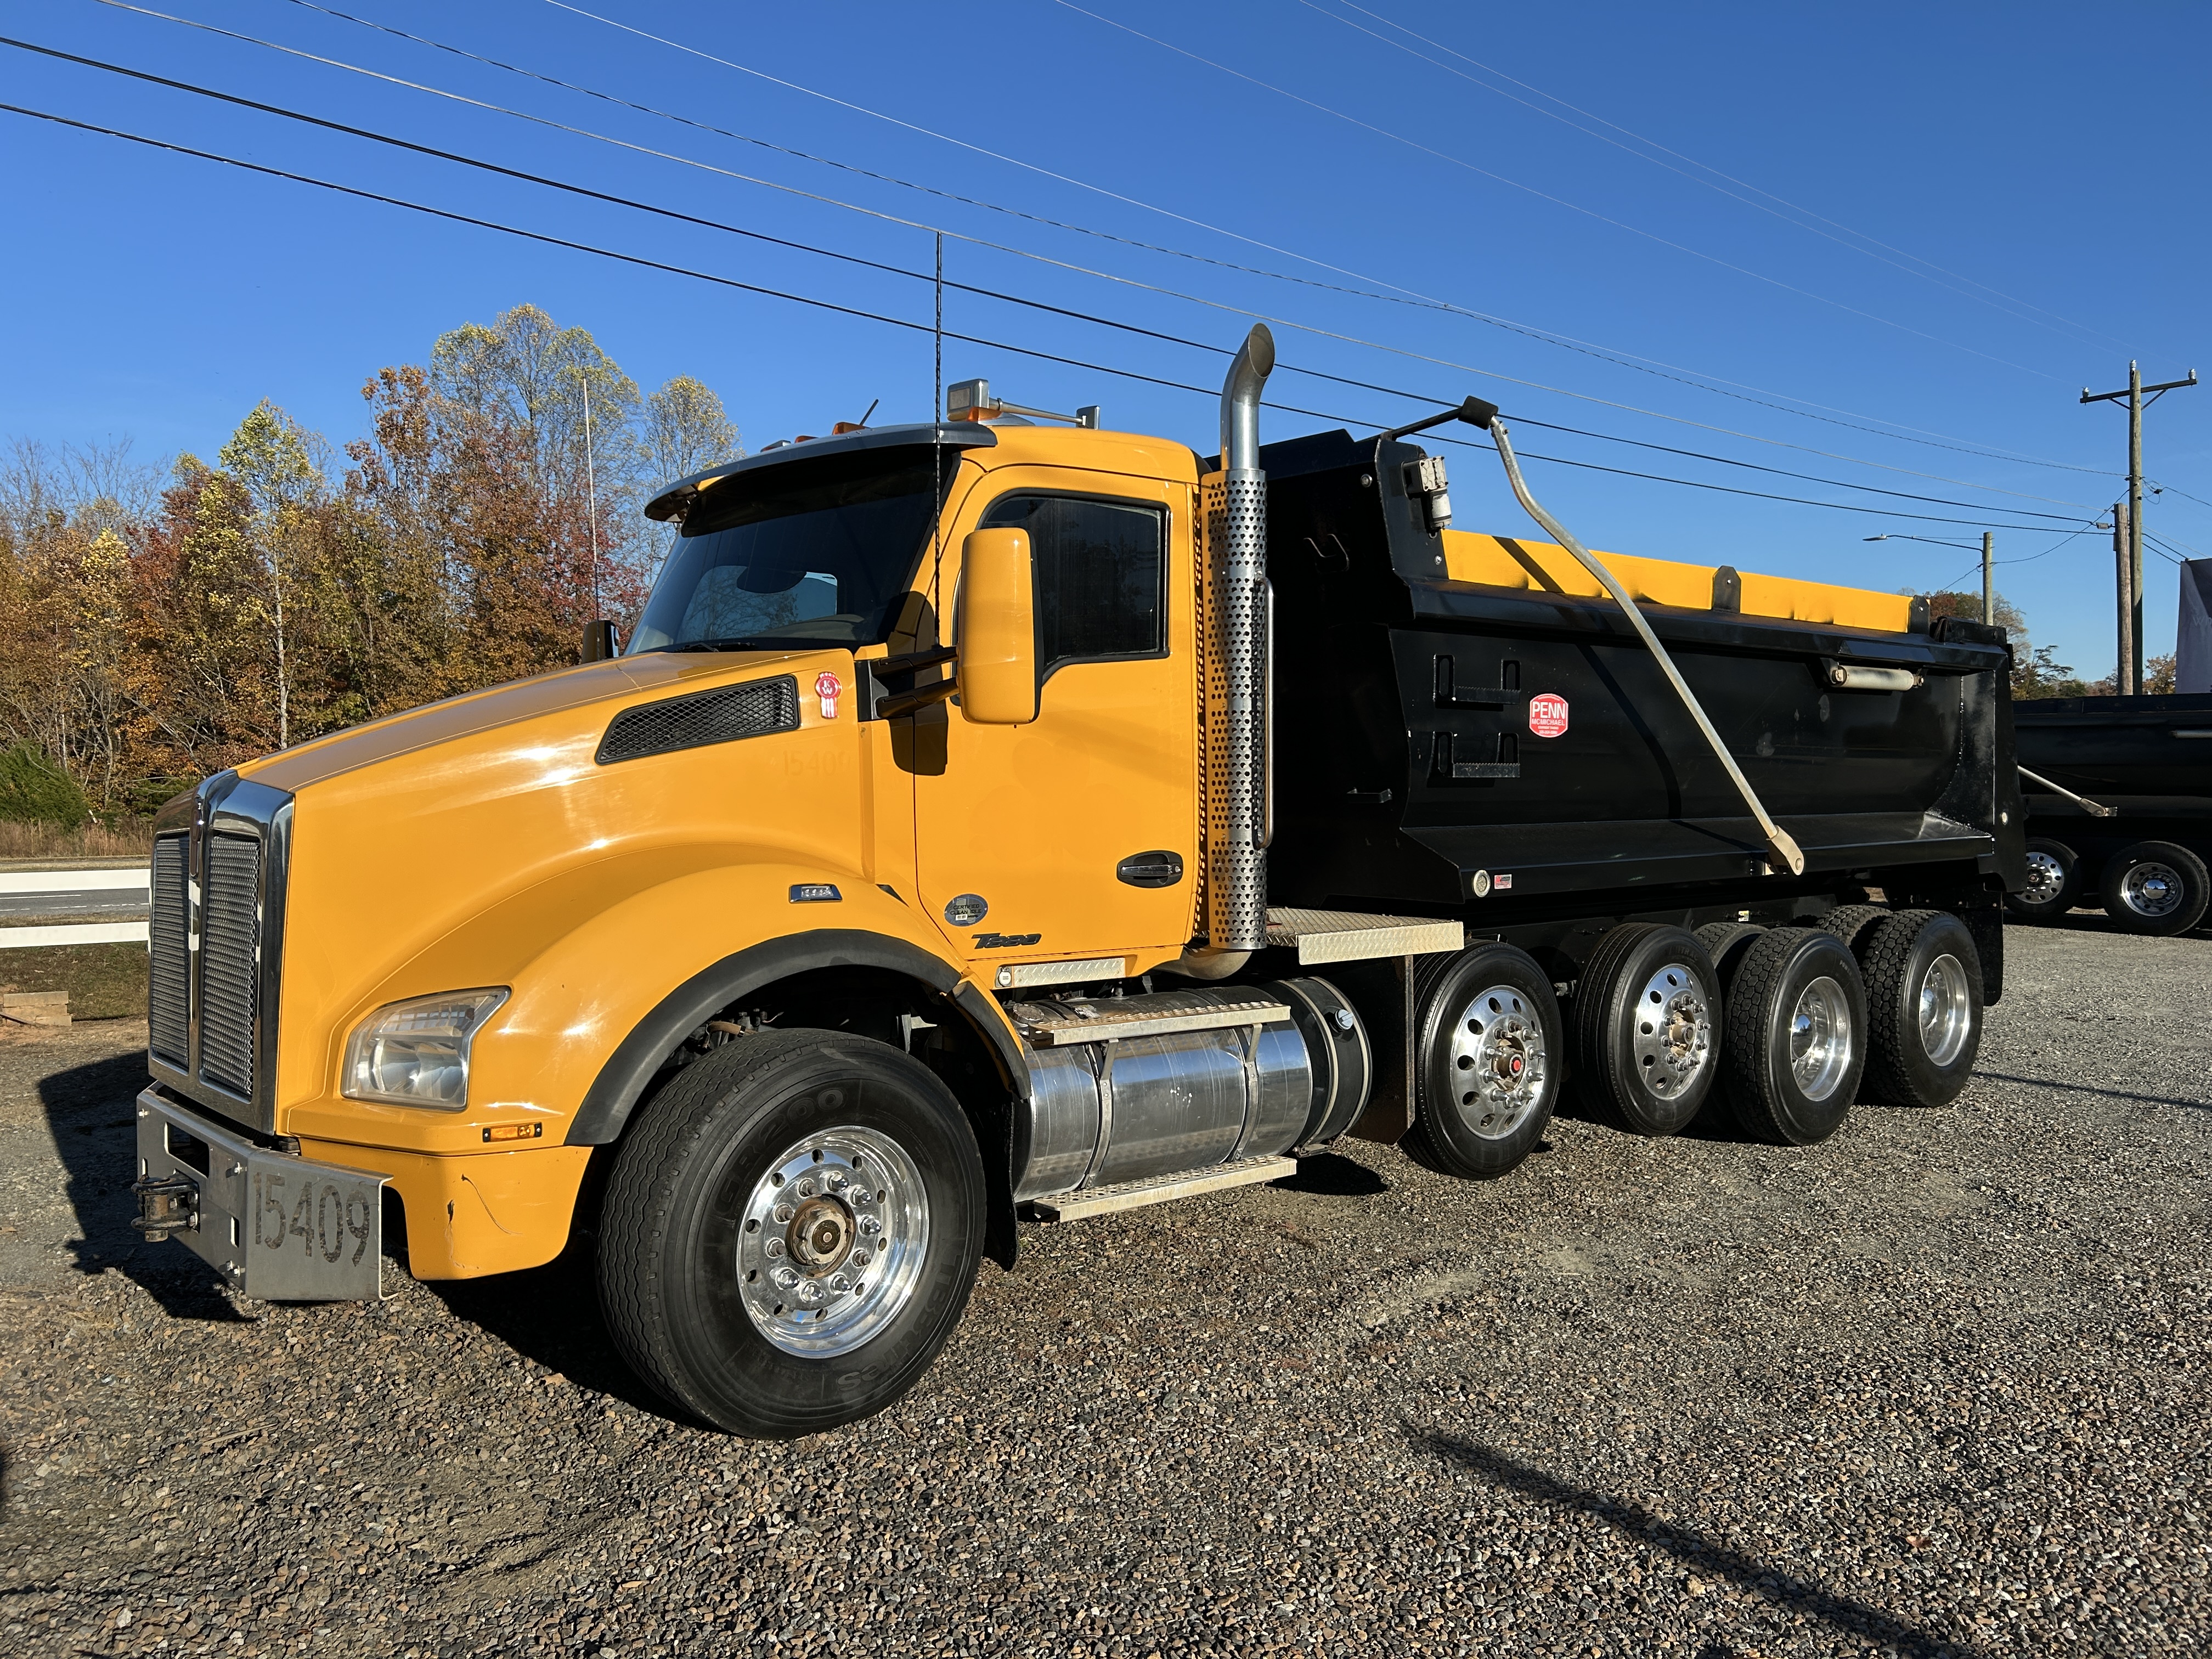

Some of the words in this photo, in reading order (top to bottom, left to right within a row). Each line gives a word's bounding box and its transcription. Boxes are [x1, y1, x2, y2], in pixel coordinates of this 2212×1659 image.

[1532, 701, 1566, 720] PENN
[971, 933, 1042, 950] T880
[714, 1088, 847, 1213] GR200
[253, 1171, 370, 1268] 15409
